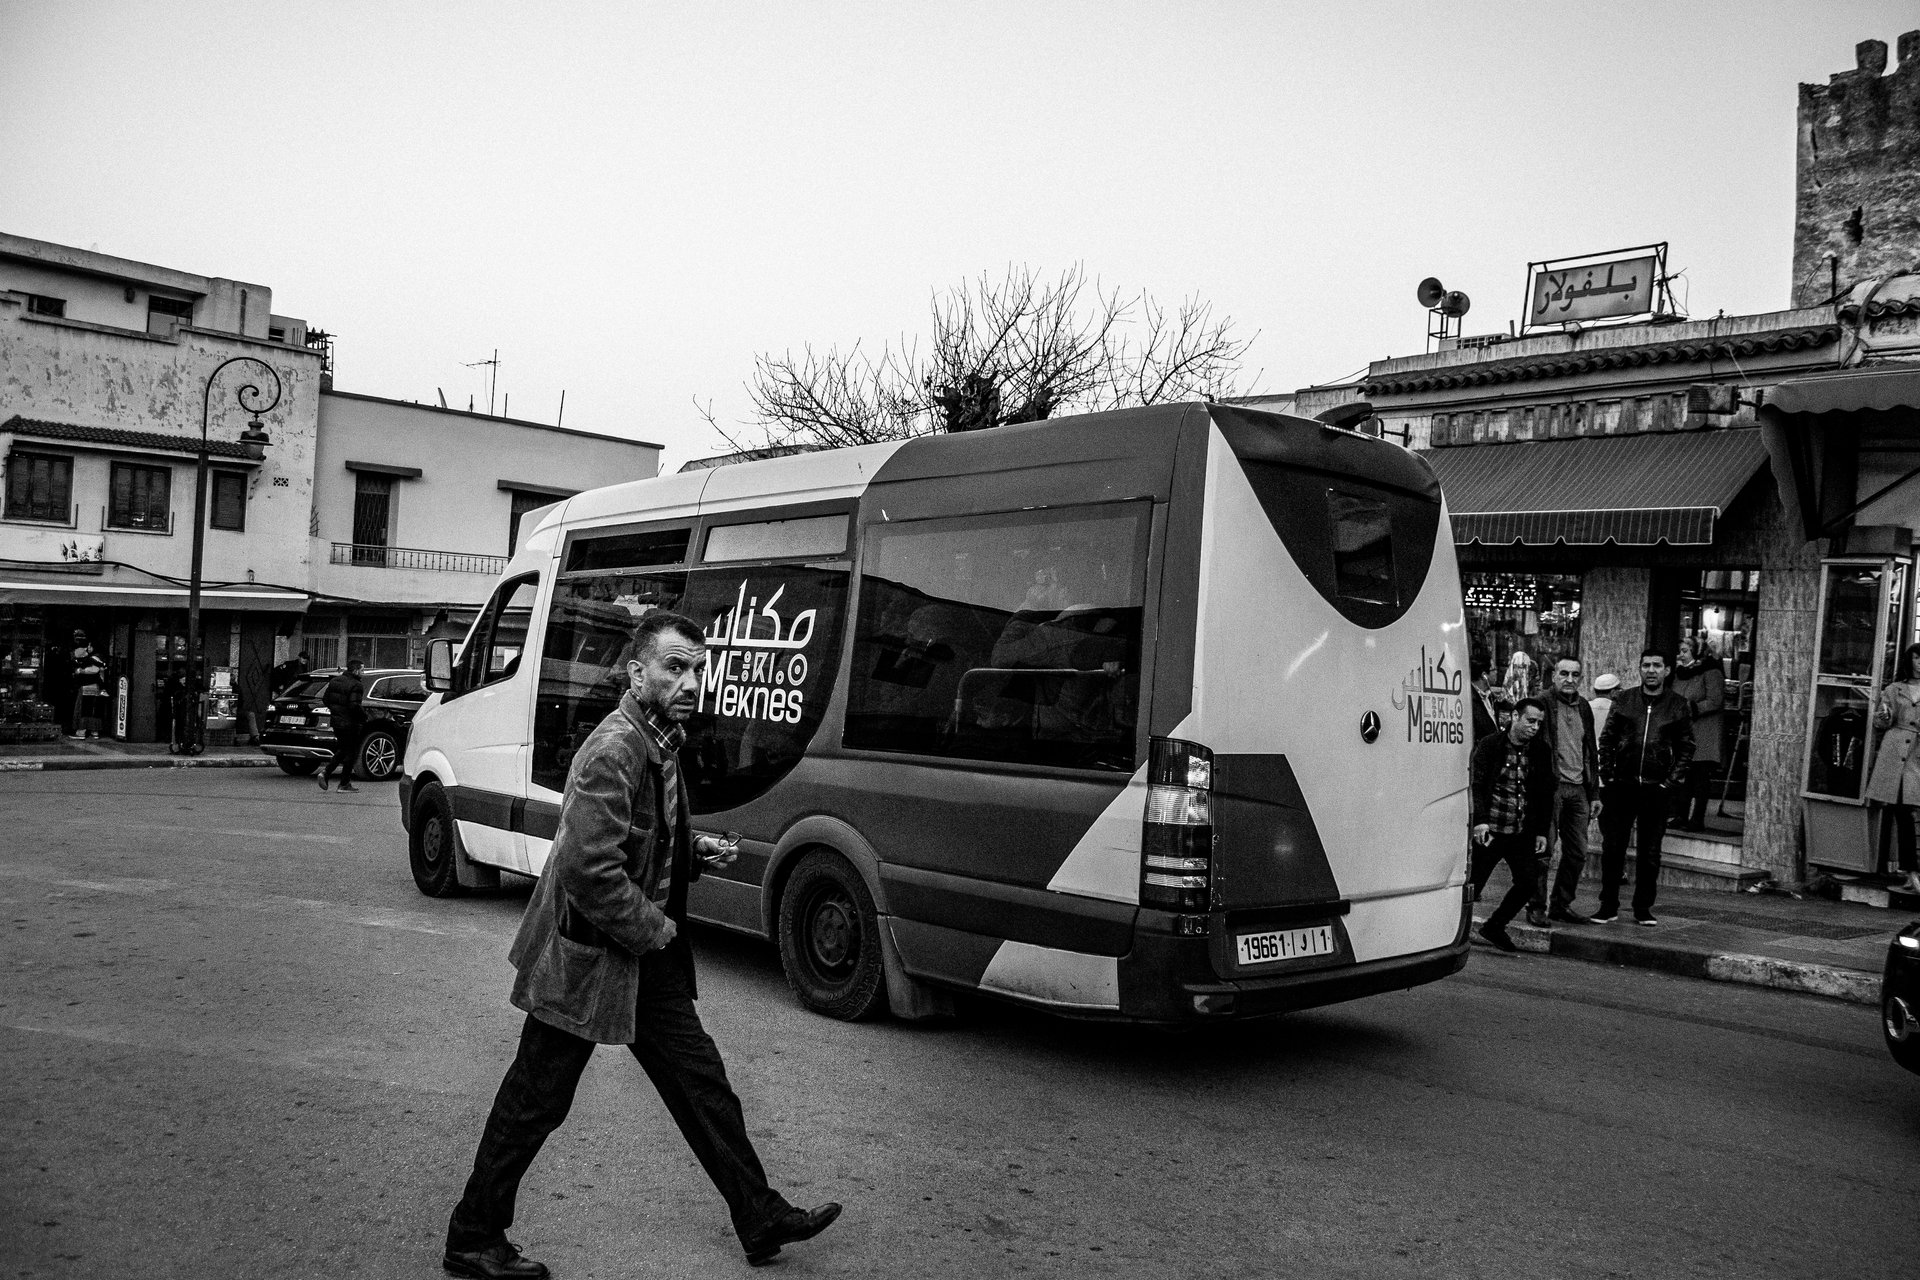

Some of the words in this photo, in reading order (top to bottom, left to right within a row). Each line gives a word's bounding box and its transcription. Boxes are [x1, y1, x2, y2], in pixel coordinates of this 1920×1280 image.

[698, 650, 804, 724] Meknes
[1392, 644, 1462, 711] مكناس
[1408, 695, 1464, 744] Meknes
[1244, 934, 1286, 960] 19661
